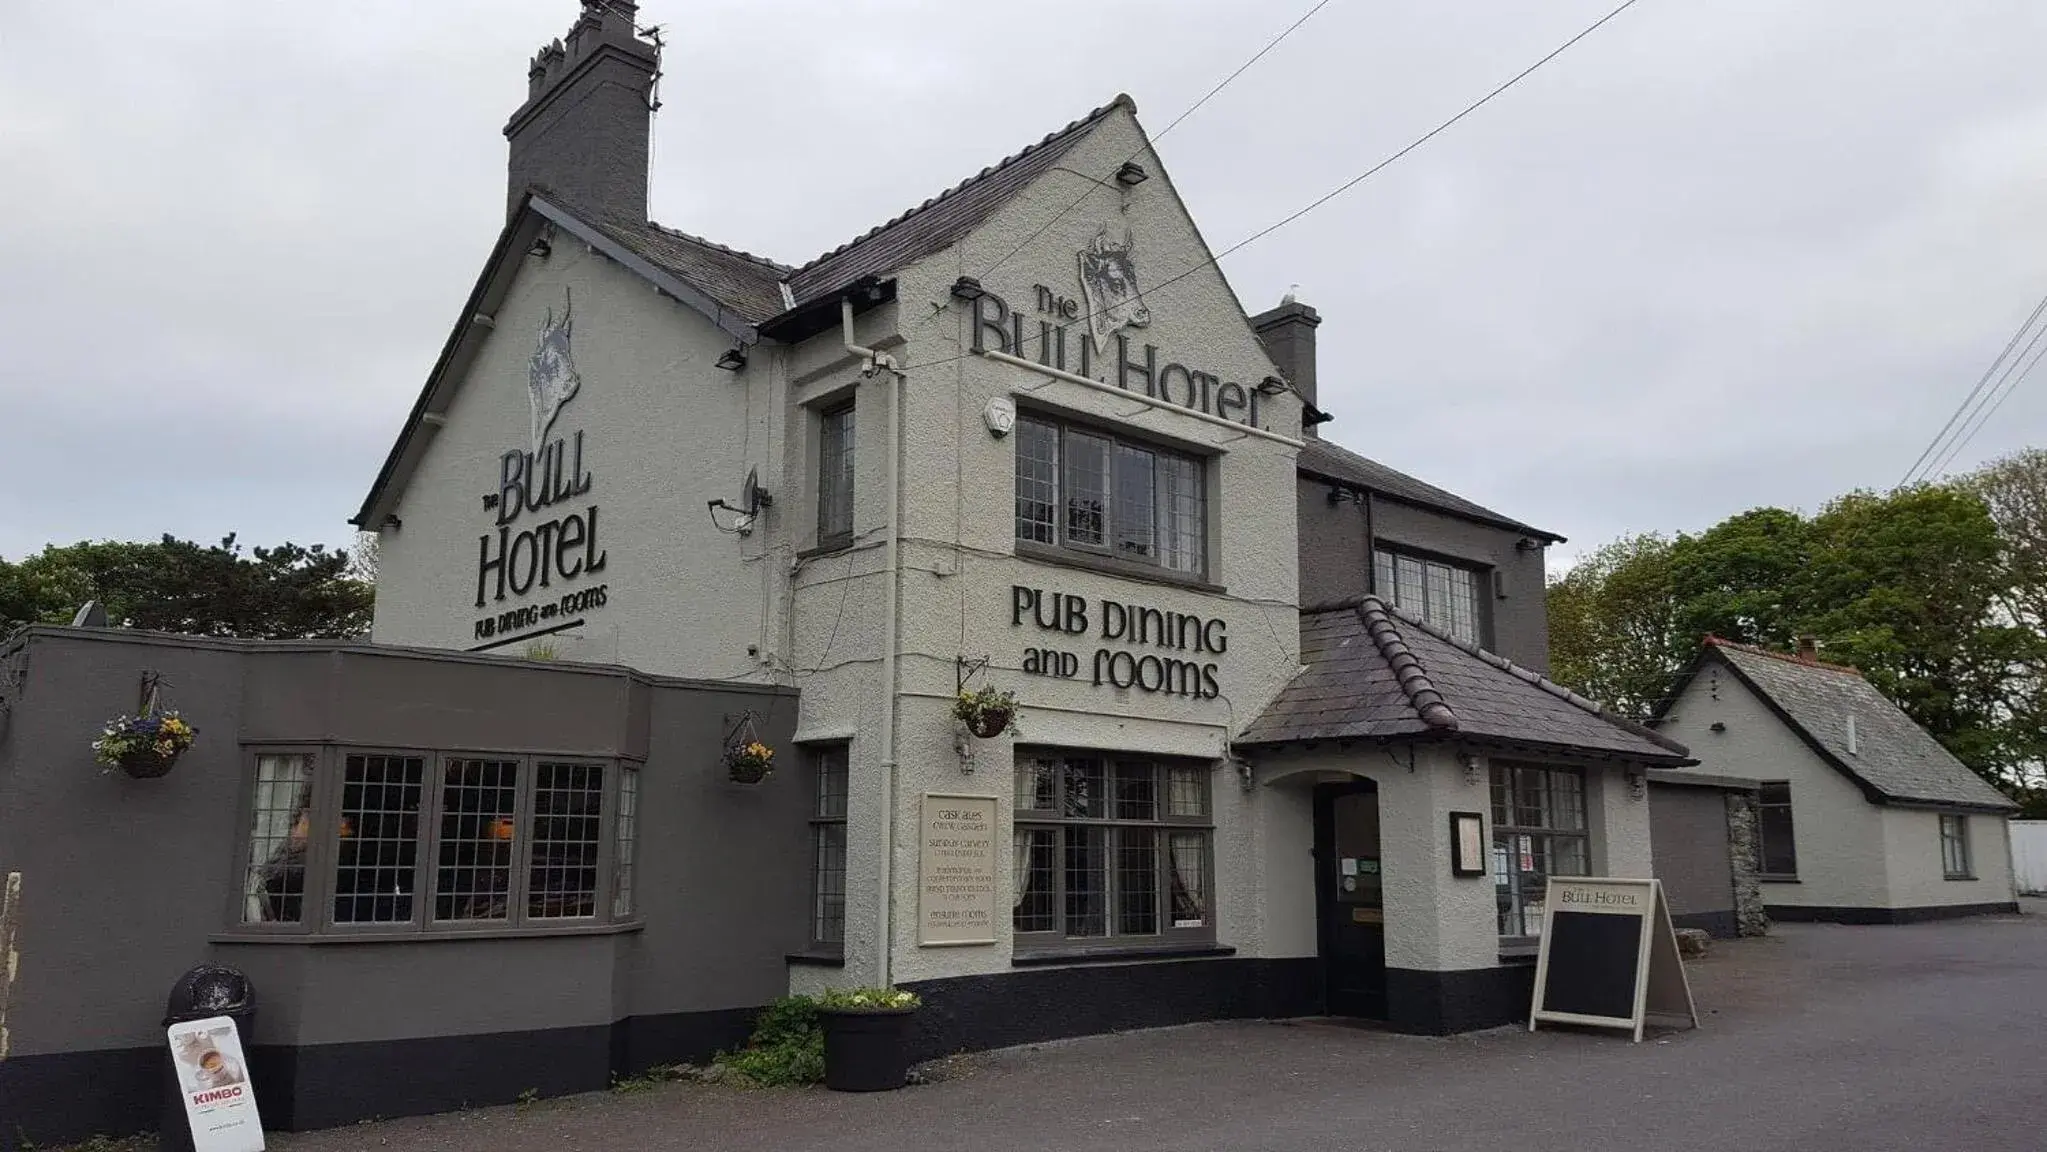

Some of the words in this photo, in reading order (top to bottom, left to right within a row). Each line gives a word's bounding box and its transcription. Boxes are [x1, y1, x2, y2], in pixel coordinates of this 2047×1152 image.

[496, 429, 592, 526] BULL
[1012, 585, 1088, 635] PUB
[475, 617, 496, 640] PUB
[193, 1086, 242, 1105] KIMBO
